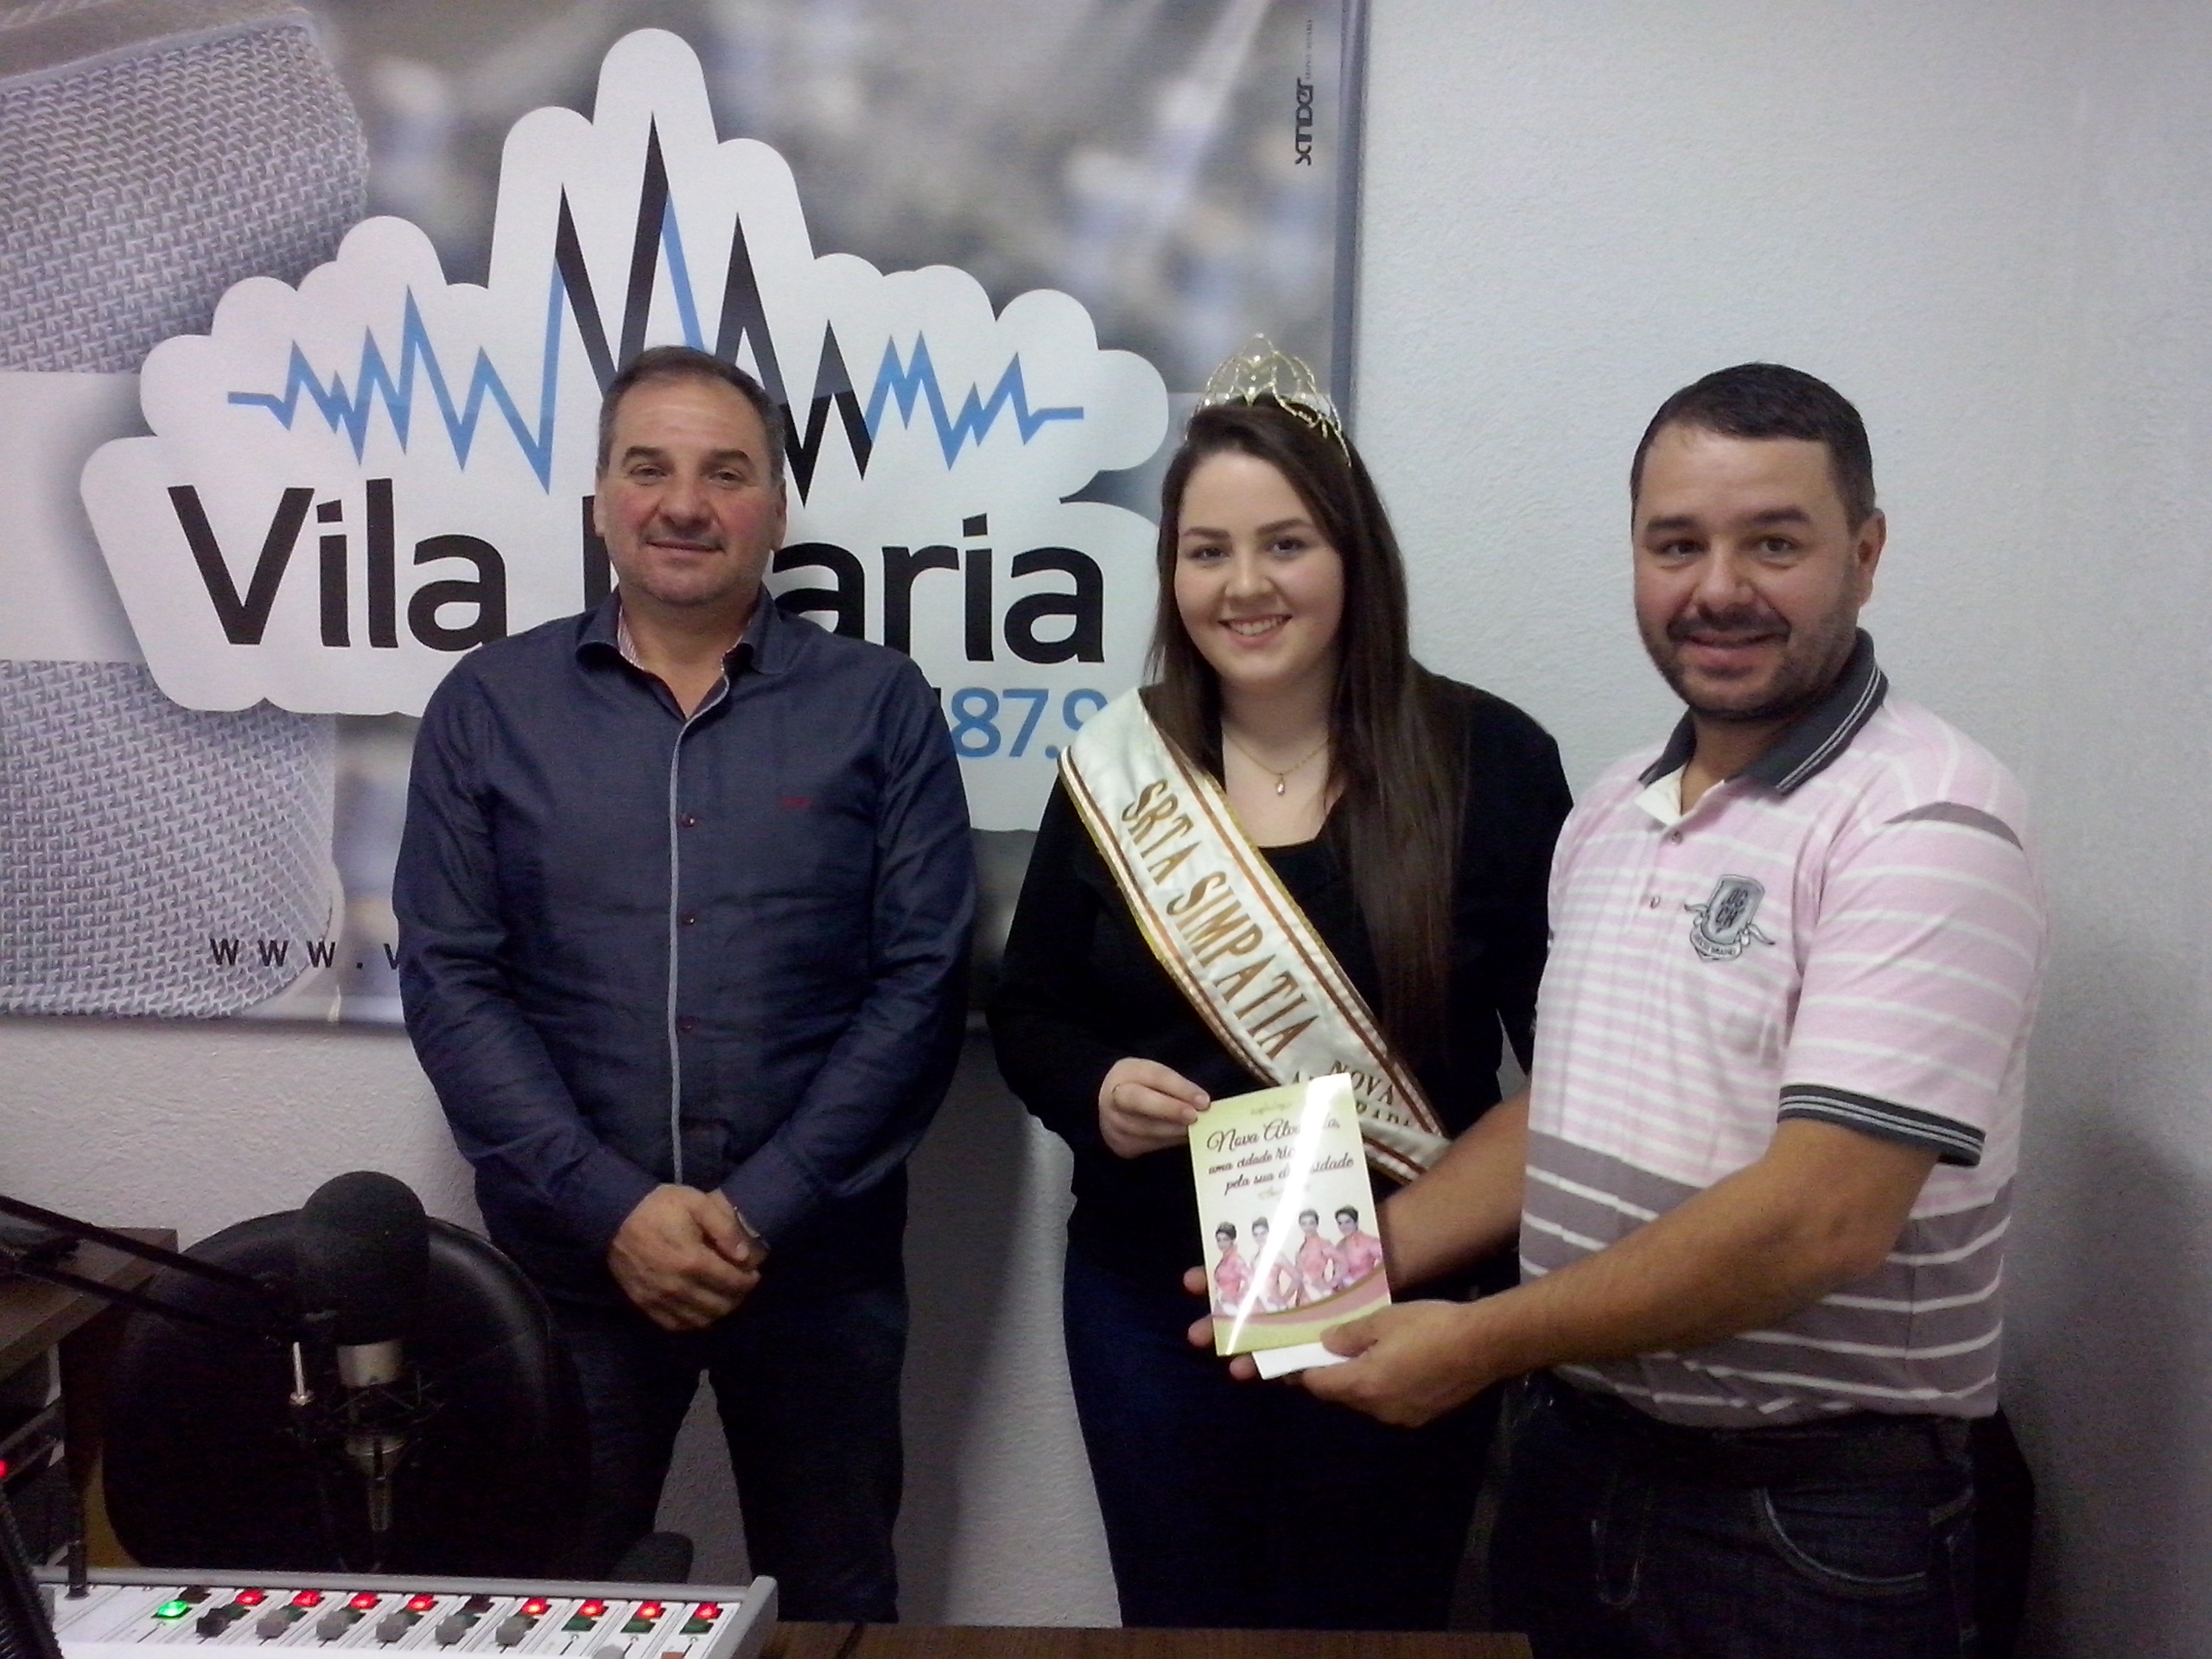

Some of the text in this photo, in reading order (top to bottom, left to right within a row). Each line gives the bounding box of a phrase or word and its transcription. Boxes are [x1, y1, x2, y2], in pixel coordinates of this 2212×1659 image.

[168, 478, 1105, 664] Vila aria
[1122, 779, 1202, 887] SRTA
[1166, 871, 1319, 1061] SIMPATIA
[1206, 1128, 1258, 1153] Nova
[1208, 1162, 1233, 1175] uma
[1236, 1150, 1273, 1168] cidade
[1224, 1173, 1249, 1197] pela
[1253, 1173, 1274, 1185] sua
